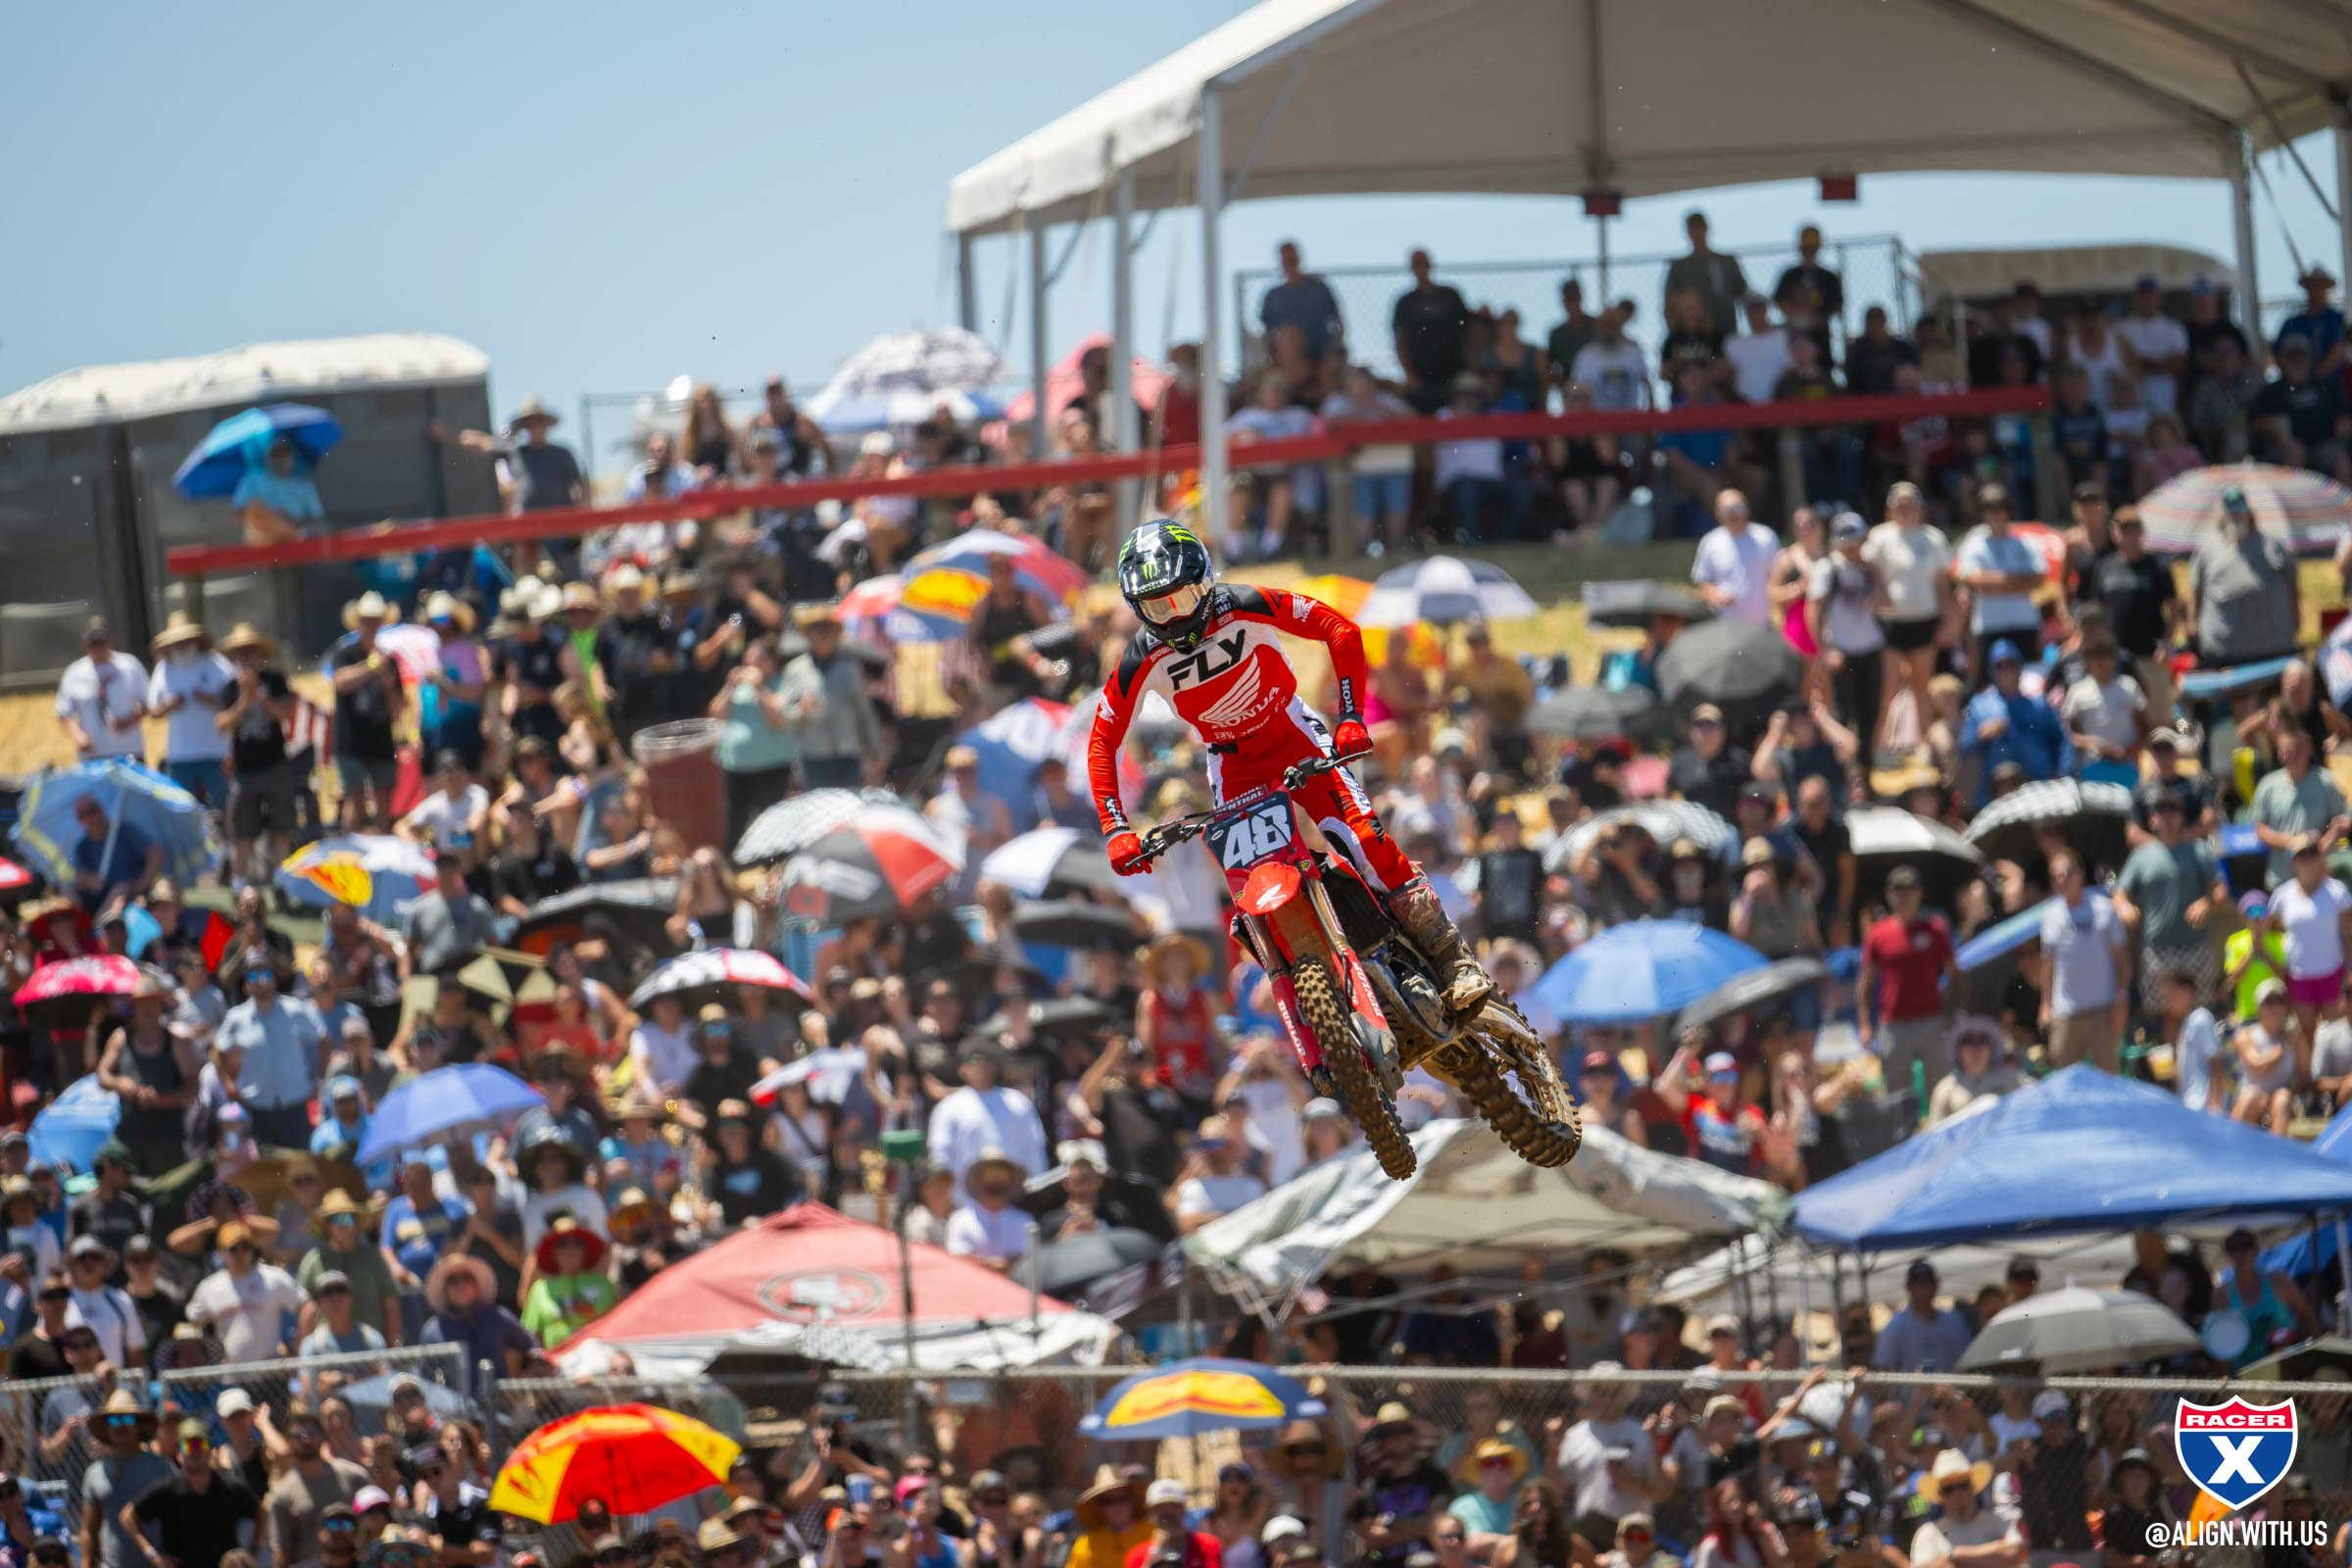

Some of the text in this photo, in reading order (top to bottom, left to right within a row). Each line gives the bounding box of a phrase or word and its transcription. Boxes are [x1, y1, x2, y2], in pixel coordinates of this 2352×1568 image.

[1166, 628, 1246, 691] FLY
[1342, 678, 1353, 713] HOA
[1223, 805, 1292, 870] 48
[1277, 999, 1306, 1056] DUNLOP
